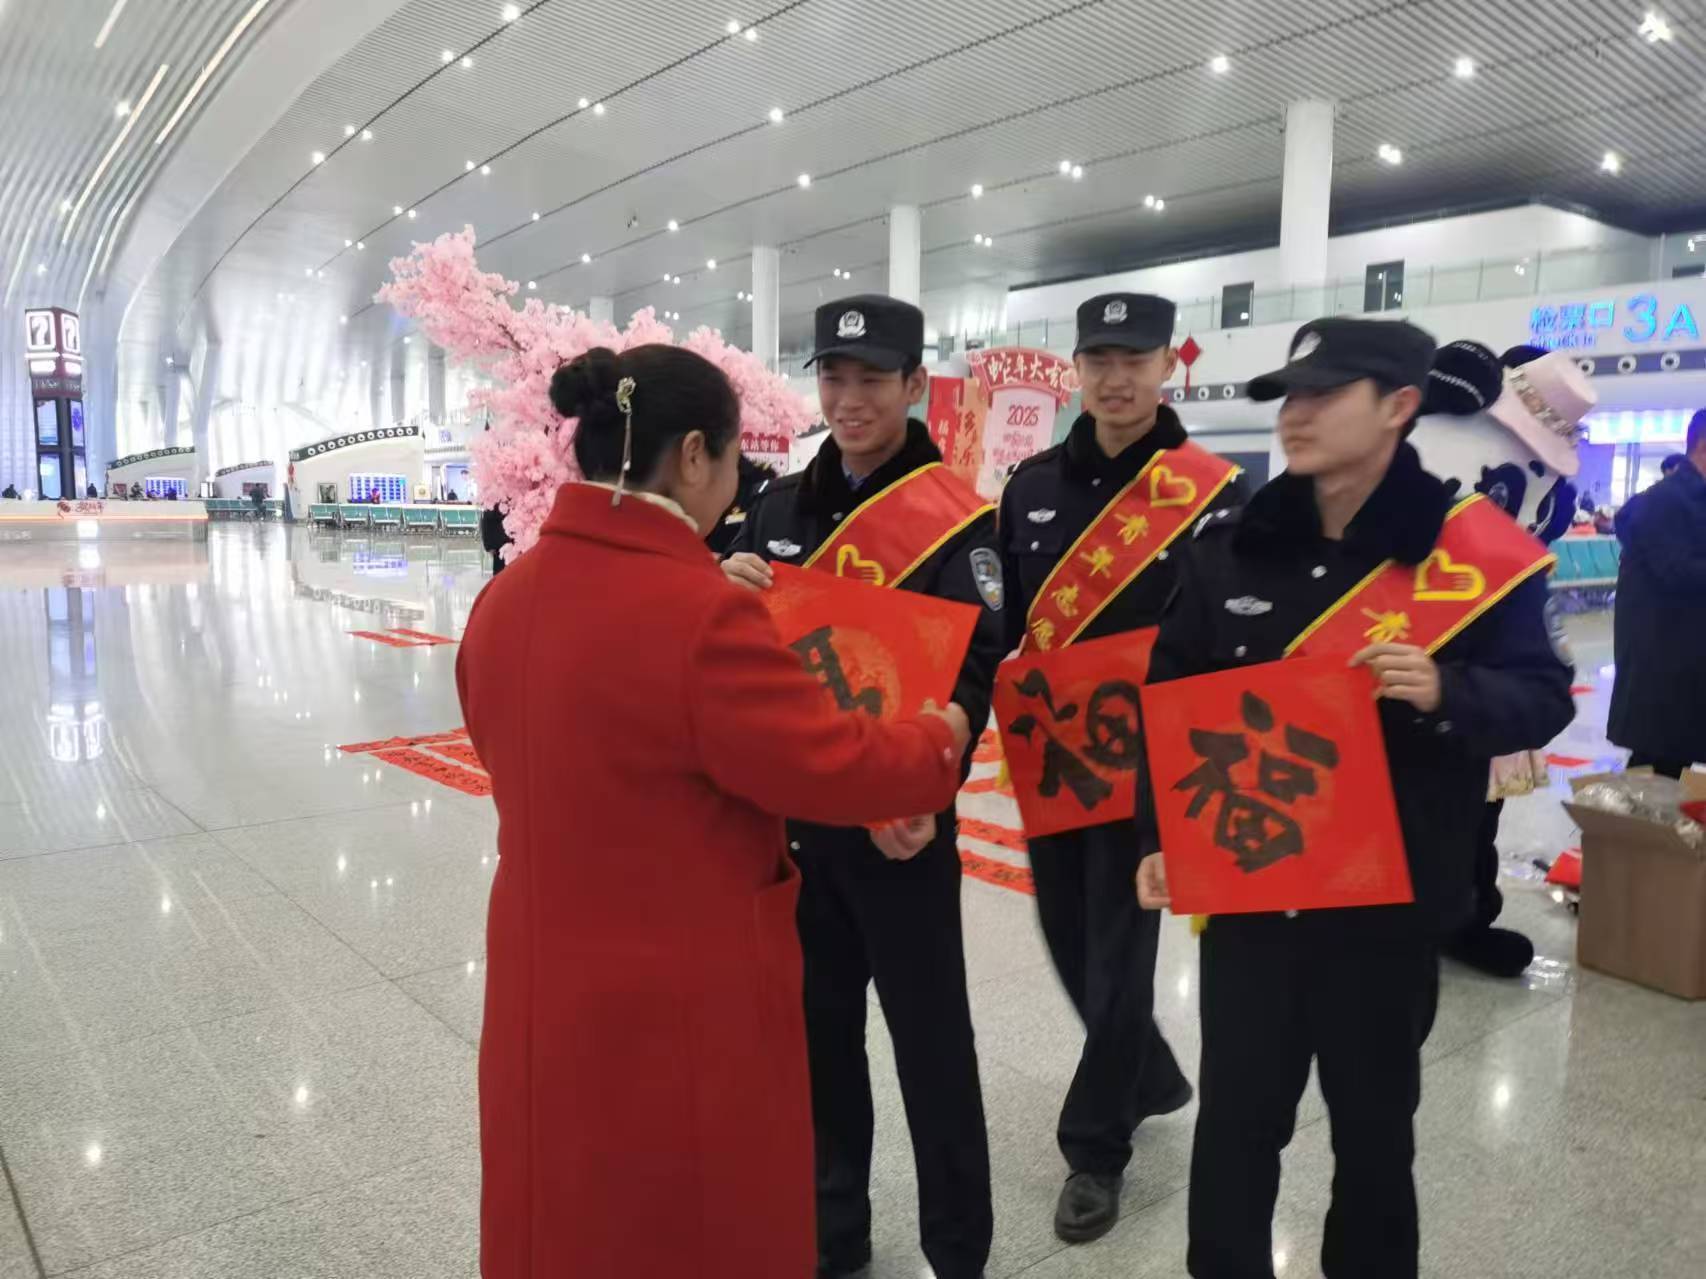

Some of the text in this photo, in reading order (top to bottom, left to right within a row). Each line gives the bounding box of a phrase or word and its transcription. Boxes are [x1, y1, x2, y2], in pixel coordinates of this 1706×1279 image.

[1623, 293, 1699, 343] 3A
[987, 351, 1062, 388] 蛇年大吉
[1006, 404, 1041, 426] 2025
[1169, 689, 1341, 874] 福
